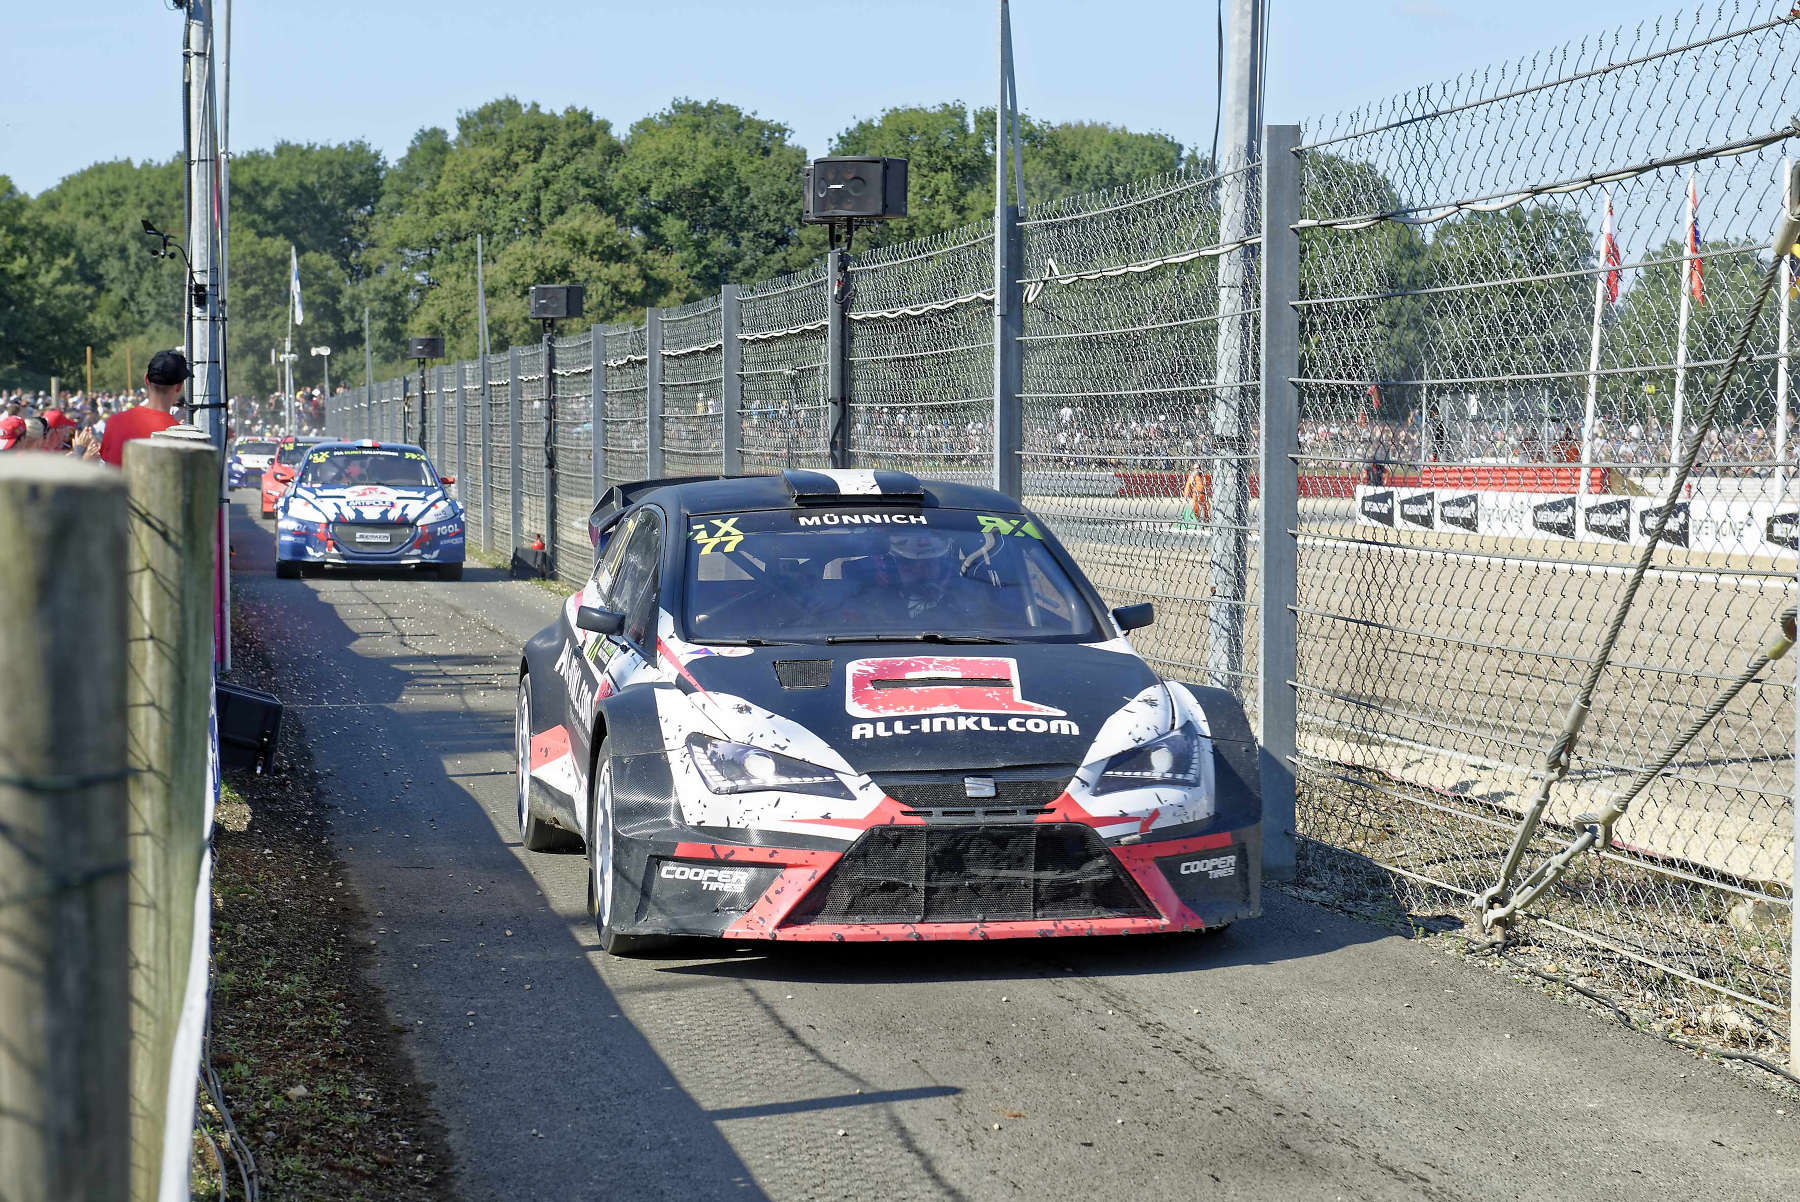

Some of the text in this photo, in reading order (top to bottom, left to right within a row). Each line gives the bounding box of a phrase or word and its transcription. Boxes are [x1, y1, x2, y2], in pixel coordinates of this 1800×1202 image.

[798, 513, 928, 526] MÜNNICH
[697, 535, 745, 555] 77
[1180, 856, 1236, 875] COOPER
[660, 866, 749, 884] COOPER
[701, 881, 747, 893] TIRES
